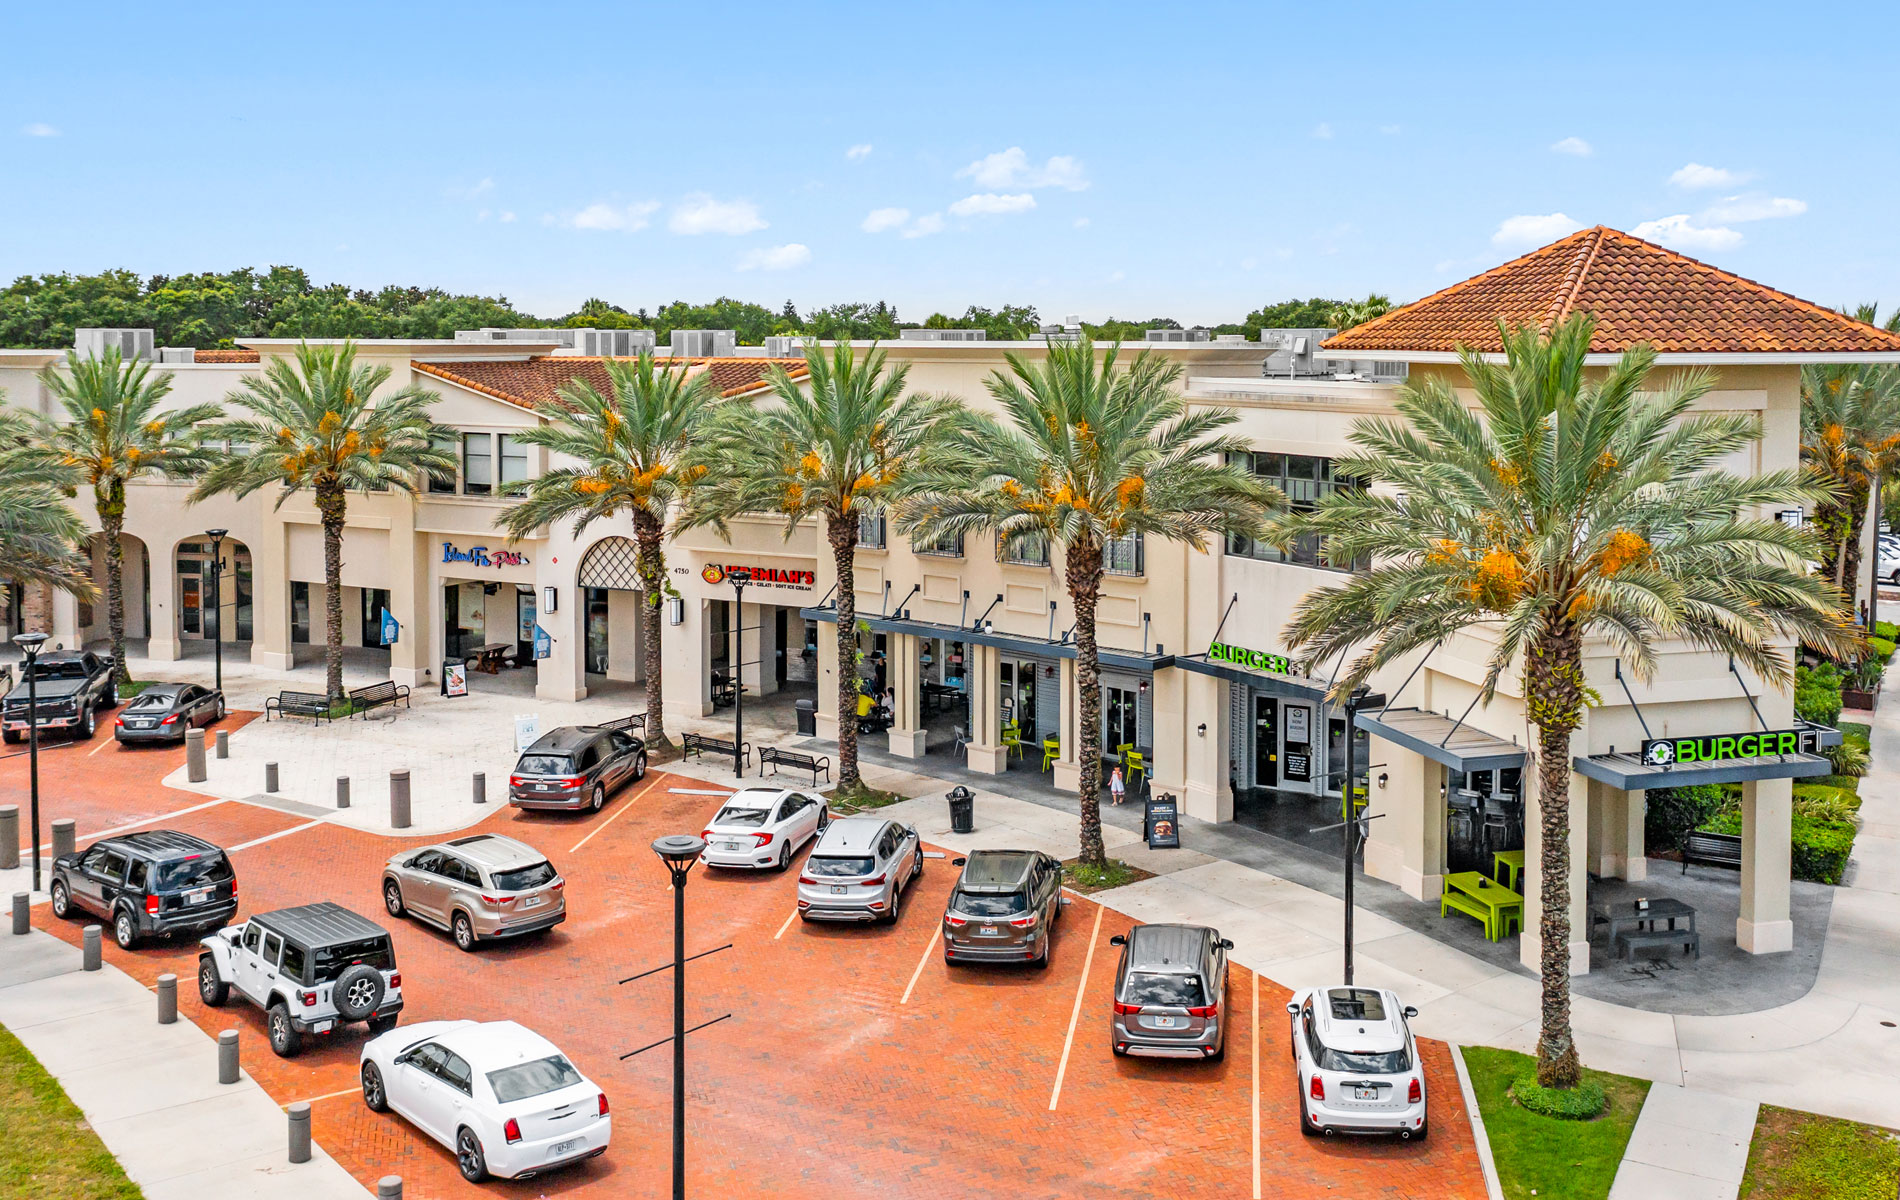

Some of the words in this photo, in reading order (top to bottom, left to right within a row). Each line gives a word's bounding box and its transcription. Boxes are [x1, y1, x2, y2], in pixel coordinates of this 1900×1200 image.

[442, 542, 474, 562] Island
[674, 567, 690, 575] 4750
[1676, 730, 1822, 764] BURGERFI
